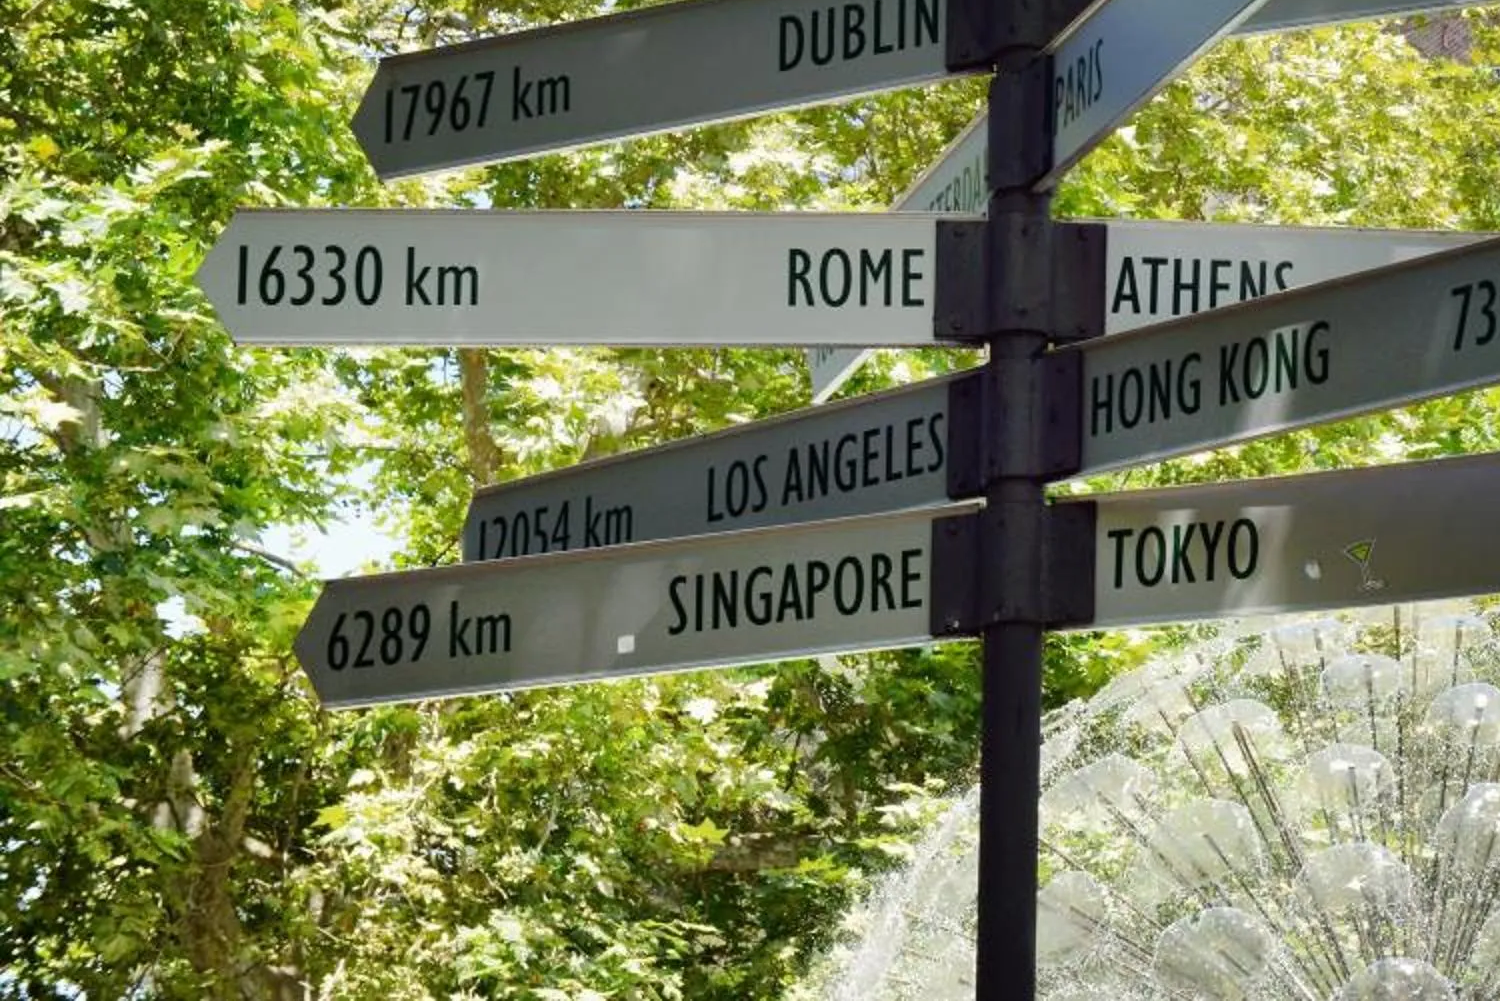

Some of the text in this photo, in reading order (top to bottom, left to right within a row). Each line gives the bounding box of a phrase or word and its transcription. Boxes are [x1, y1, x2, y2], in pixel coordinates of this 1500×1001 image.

[384, 70, 495, 144] 17967
[512, 65, 570, 122] km
[1055, 38, 1103, 129] PARIS
[237, 244, 925, 308] 16330 km ROME
[1090, 352, 1202, 437] HONG
[1219, 320, 1330, 407] KONG
[478, 412, 944, 561] 12054 km LOS ANGELES
[1107, 518, 1259, 589] TOKYO
[327, 548, 923, 672] 6289 km SINGAPORE
